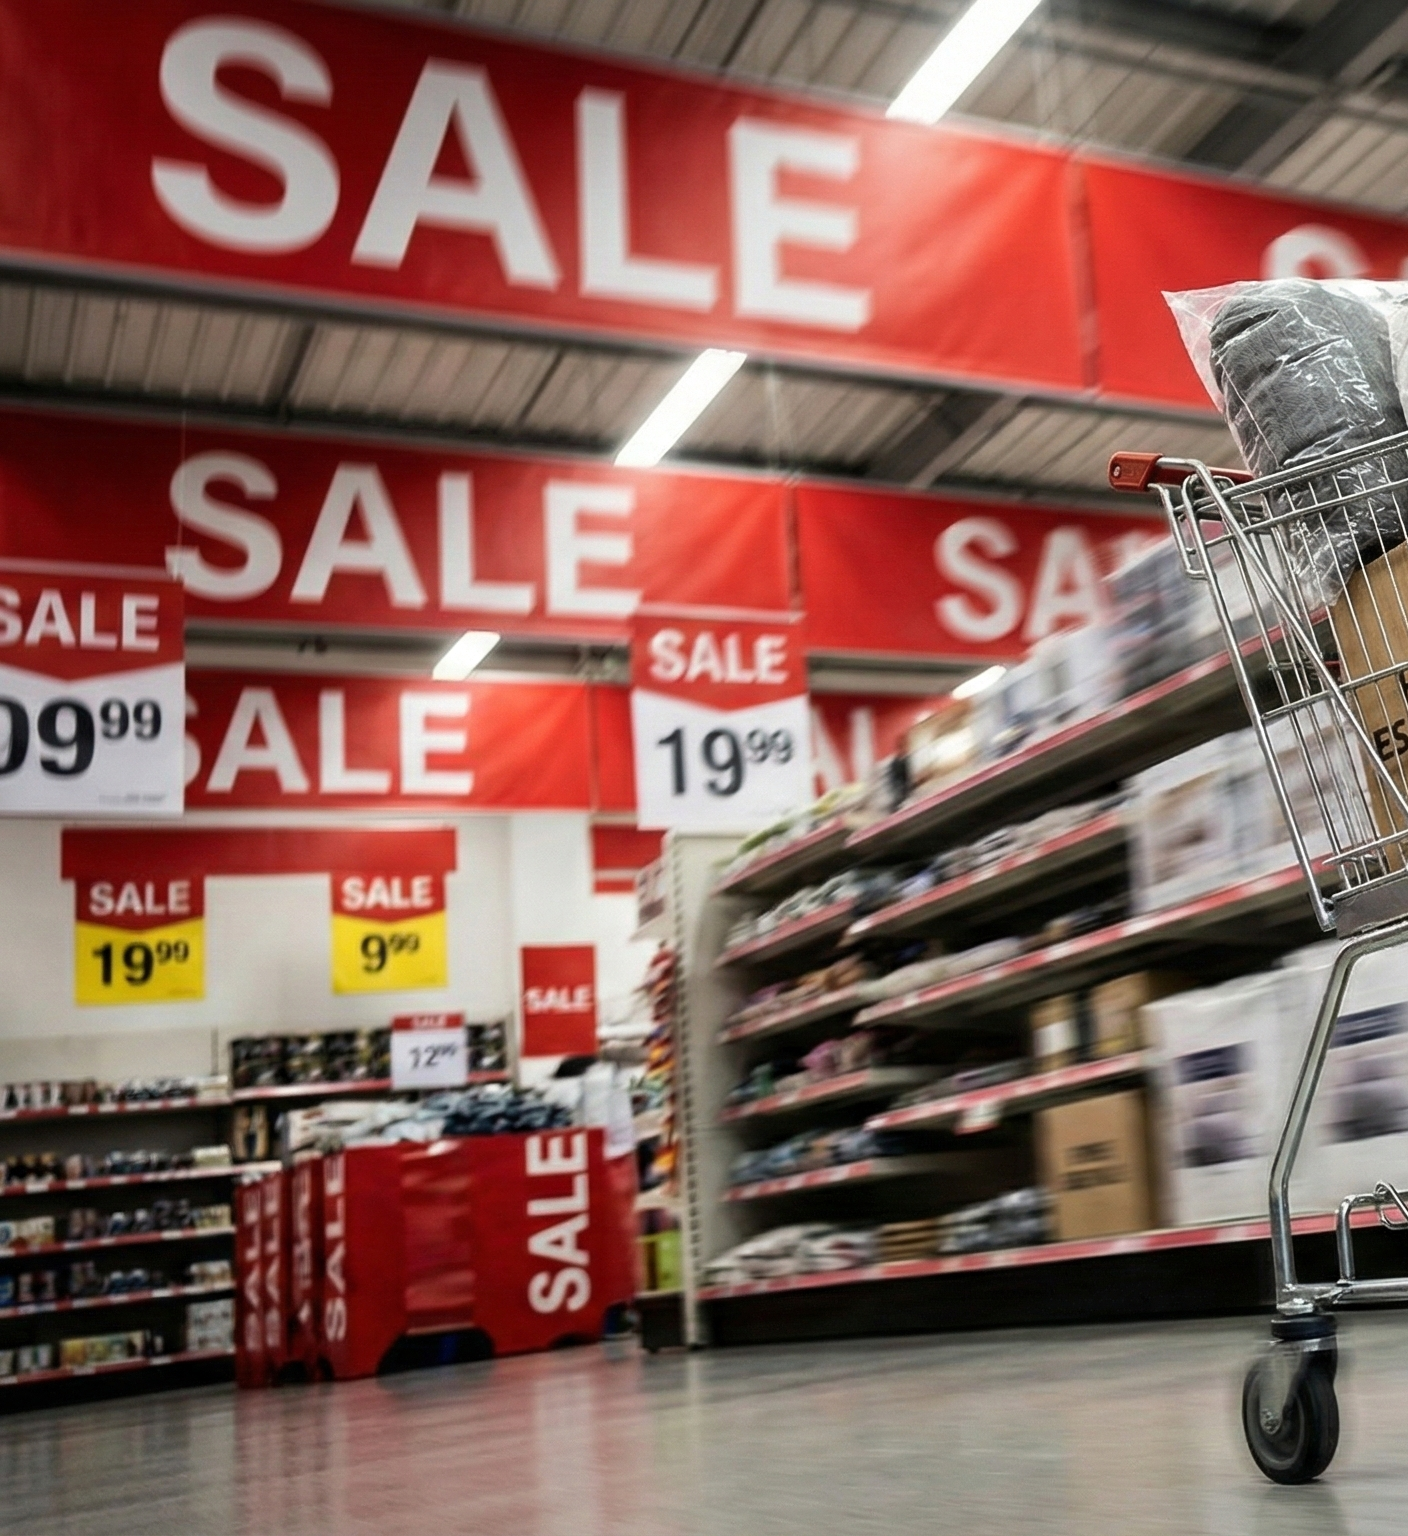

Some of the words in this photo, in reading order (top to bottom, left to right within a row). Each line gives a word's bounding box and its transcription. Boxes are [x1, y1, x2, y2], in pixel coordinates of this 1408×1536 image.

[152, 15, 873, 331] SALE
[165, 450, 643, 617] SALE
[650, 628, 790, 685] SALE
[184, 687, 473, 796] ALE
[89, 879, 191, 917] SALE
[341, 876, 434, 911] SALE
[524, 985, 595, 1015] SALE
[325, 1152, 346, 1342] SALE
[527, 1131, 592, 1314] SALE
